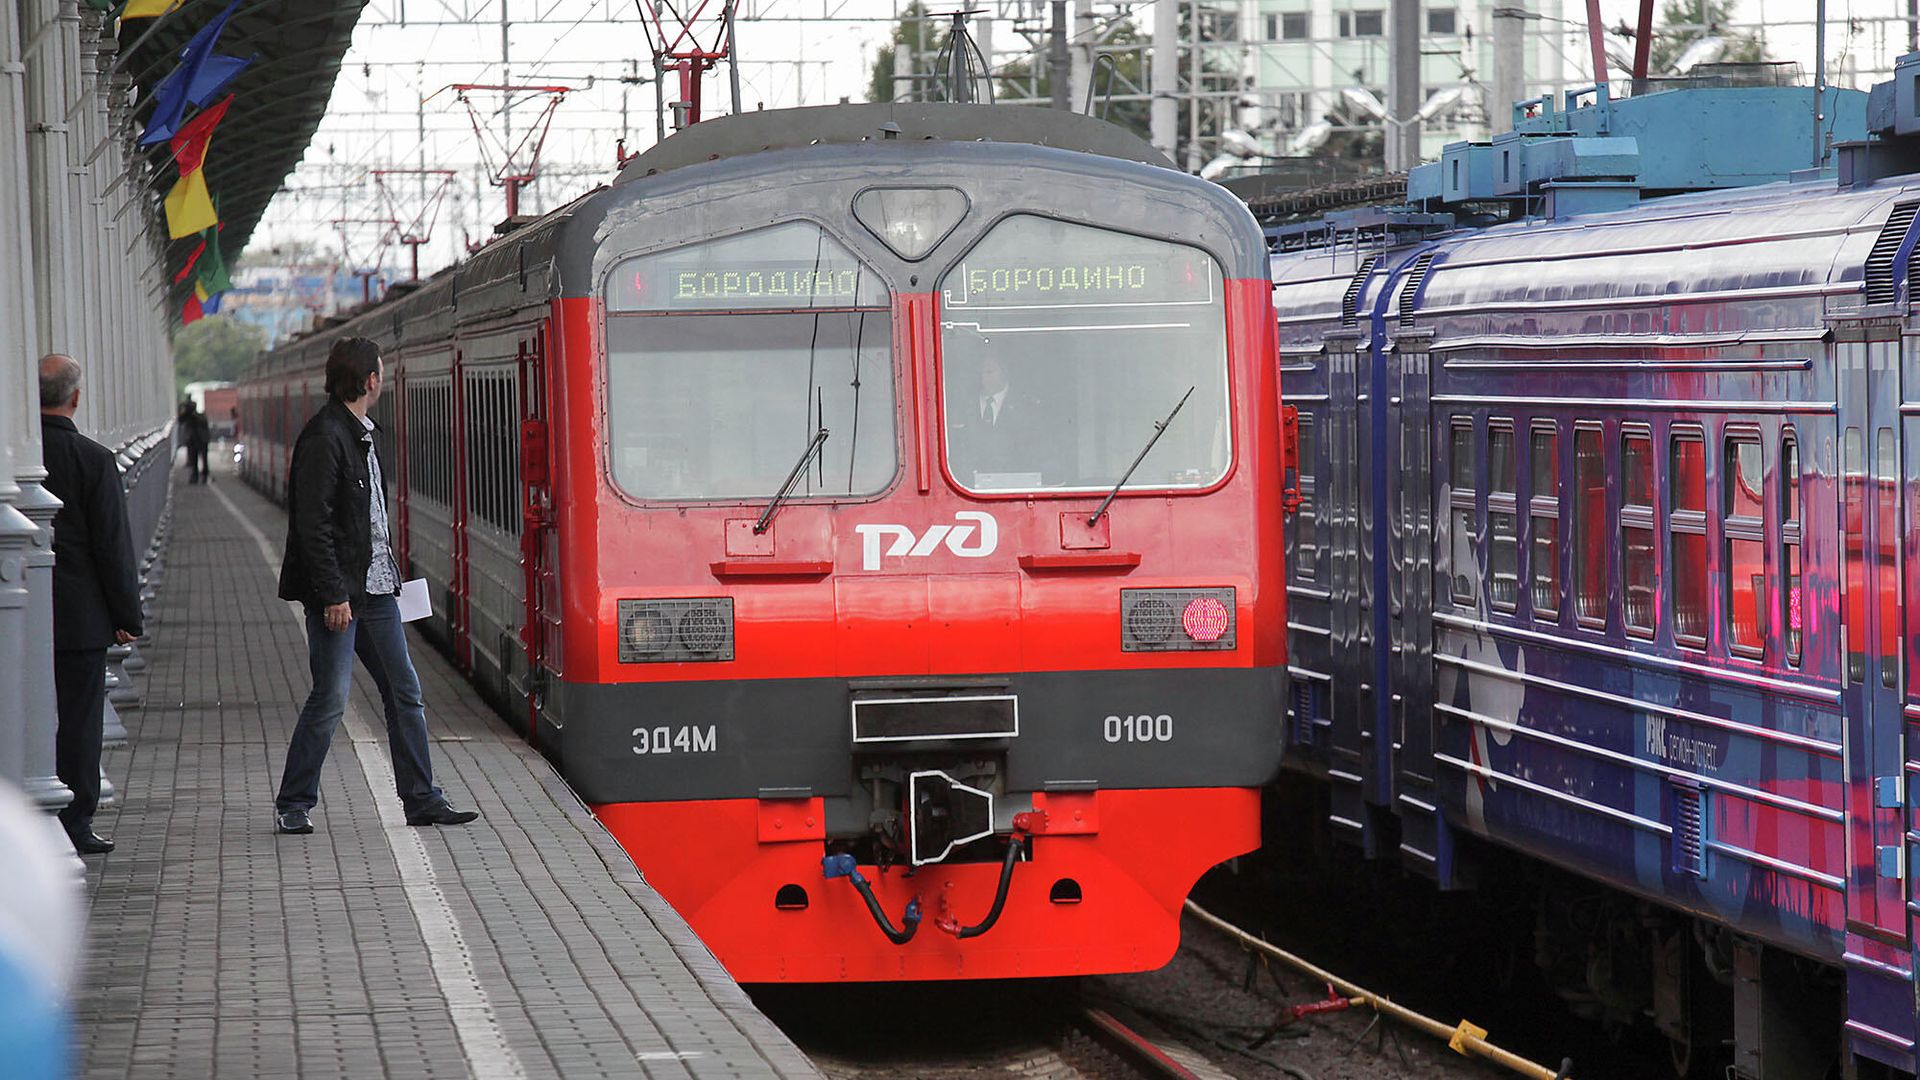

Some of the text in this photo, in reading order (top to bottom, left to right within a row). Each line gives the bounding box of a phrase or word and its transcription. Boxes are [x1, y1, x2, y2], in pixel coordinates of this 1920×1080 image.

[679, 271, 856, 297] БОРОДИНО
[970, 265, 1145, 292] БОРОДИНО
[632, 725, 716, 754] ЭД4М
[1104, 715, 1173, 742] 0100
[1646, 714, 1667, 758] РЭКС
